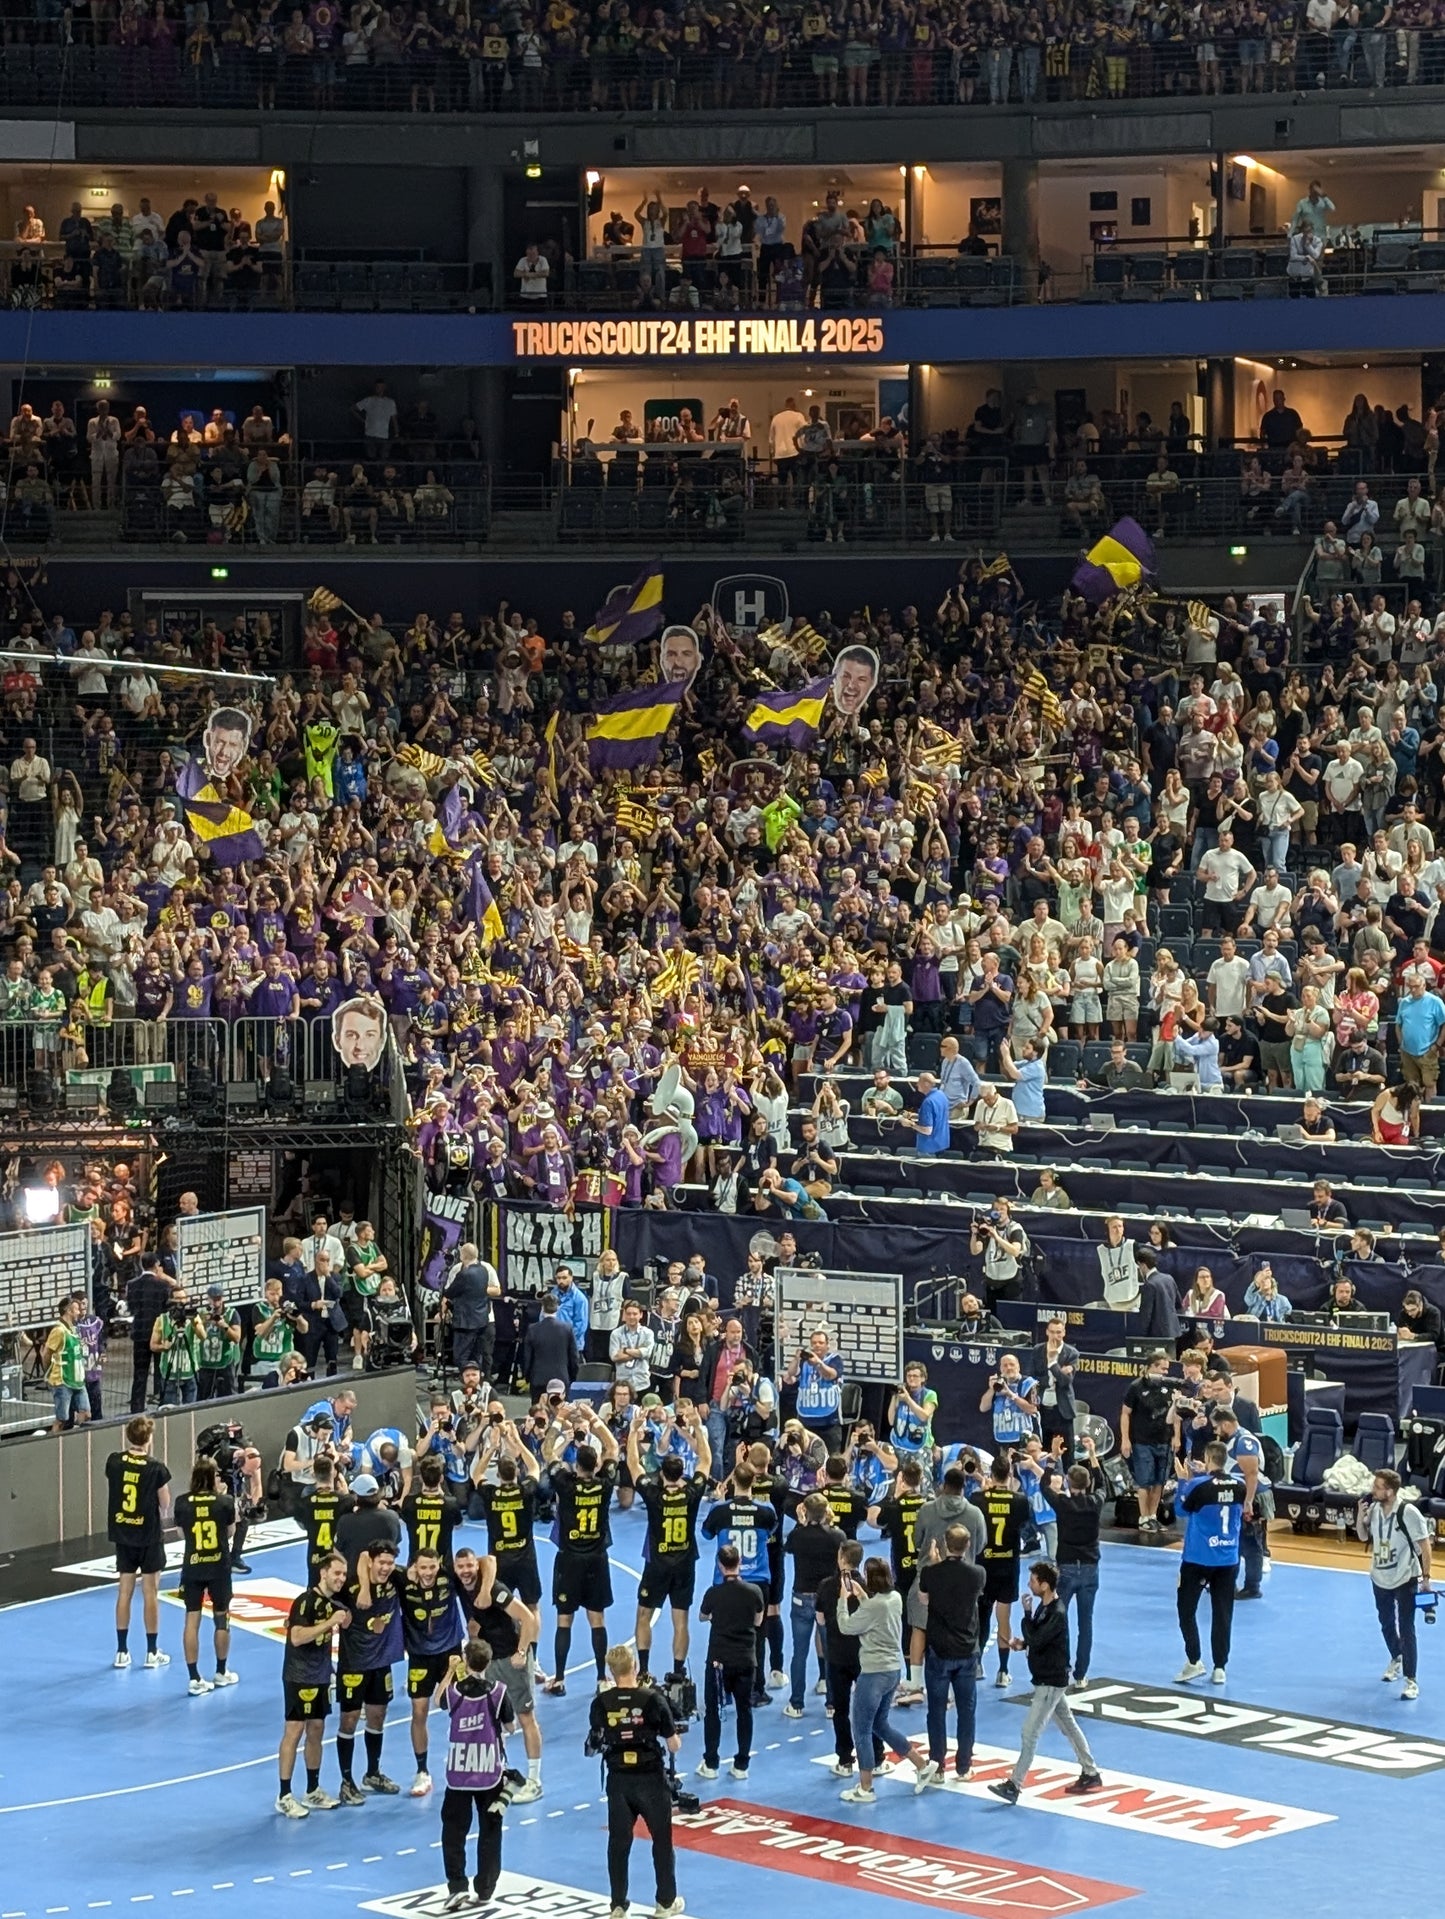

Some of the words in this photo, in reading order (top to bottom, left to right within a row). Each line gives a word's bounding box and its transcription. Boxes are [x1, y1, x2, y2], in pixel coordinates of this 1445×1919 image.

[512, 321, 691, 356] TRUCKSCOUT24
[695, 320, 735, 354] EHF
[738, 318, 815, 353] FINAL4
[821, 317, 884, 352] 2025
[427, 1193, 469, 1223] LOVE
[1068, 1312, 1085, 1325] RISE
[1263, 1328, 1326, 1346] TRUCKSCOUT24
[1327, 1333, 1341, 1347] EHF
[1342, 1334, 1370, 1349] FINAL4
[1371, 1336, 1394, 1351] 2025
[1096, 1360, 1111, 1374] EHF
[1111, 1361, 1138, 1377] FINAL4
[122, 1484, 137, 1513] 3
[500, 1511, 518, 1538] 9
[576, 1507, 598, 1533] 11
[662, 1517, 688, 1543] 18
[991, 1517, 1006, 1547] 7
[1220, 1505, 1230, 1535] 1
[191, 1520, 218, 1551] 13
[315, 1522, 332, 1550] 4
[416, 1523, 441, 1550] 17
[728, 1529, 758, 1559] 30
[459, 1712, 485, 1730] EHF
[449, 1742, 496, 1773] TEAM
